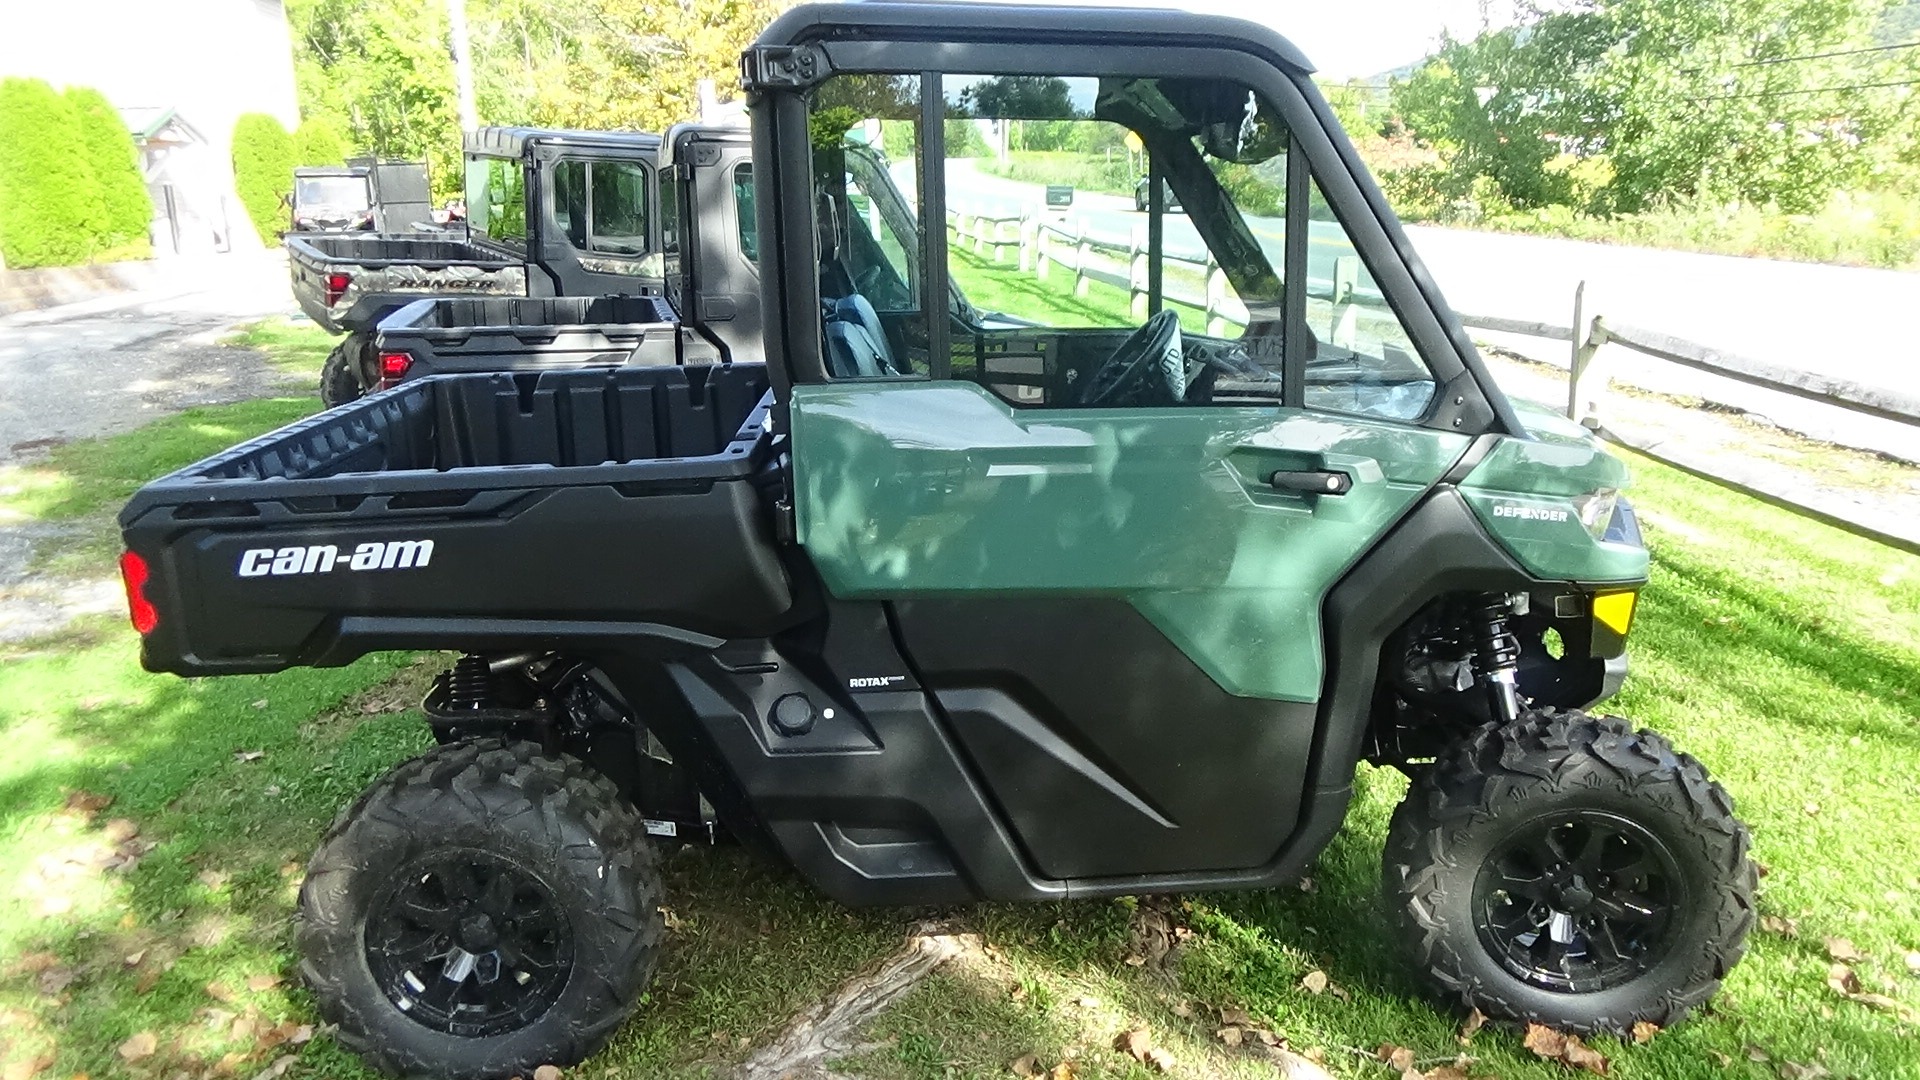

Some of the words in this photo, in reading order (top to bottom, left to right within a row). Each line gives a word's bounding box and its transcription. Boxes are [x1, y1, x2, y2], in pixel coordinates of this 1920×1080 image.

[399, 279, 496, 291] RANGER
[1493, 505, 1568, 522] DEFENDER
[239, 539, 434, 577] can-am
[849, 676, 889, 688] ROTAX
